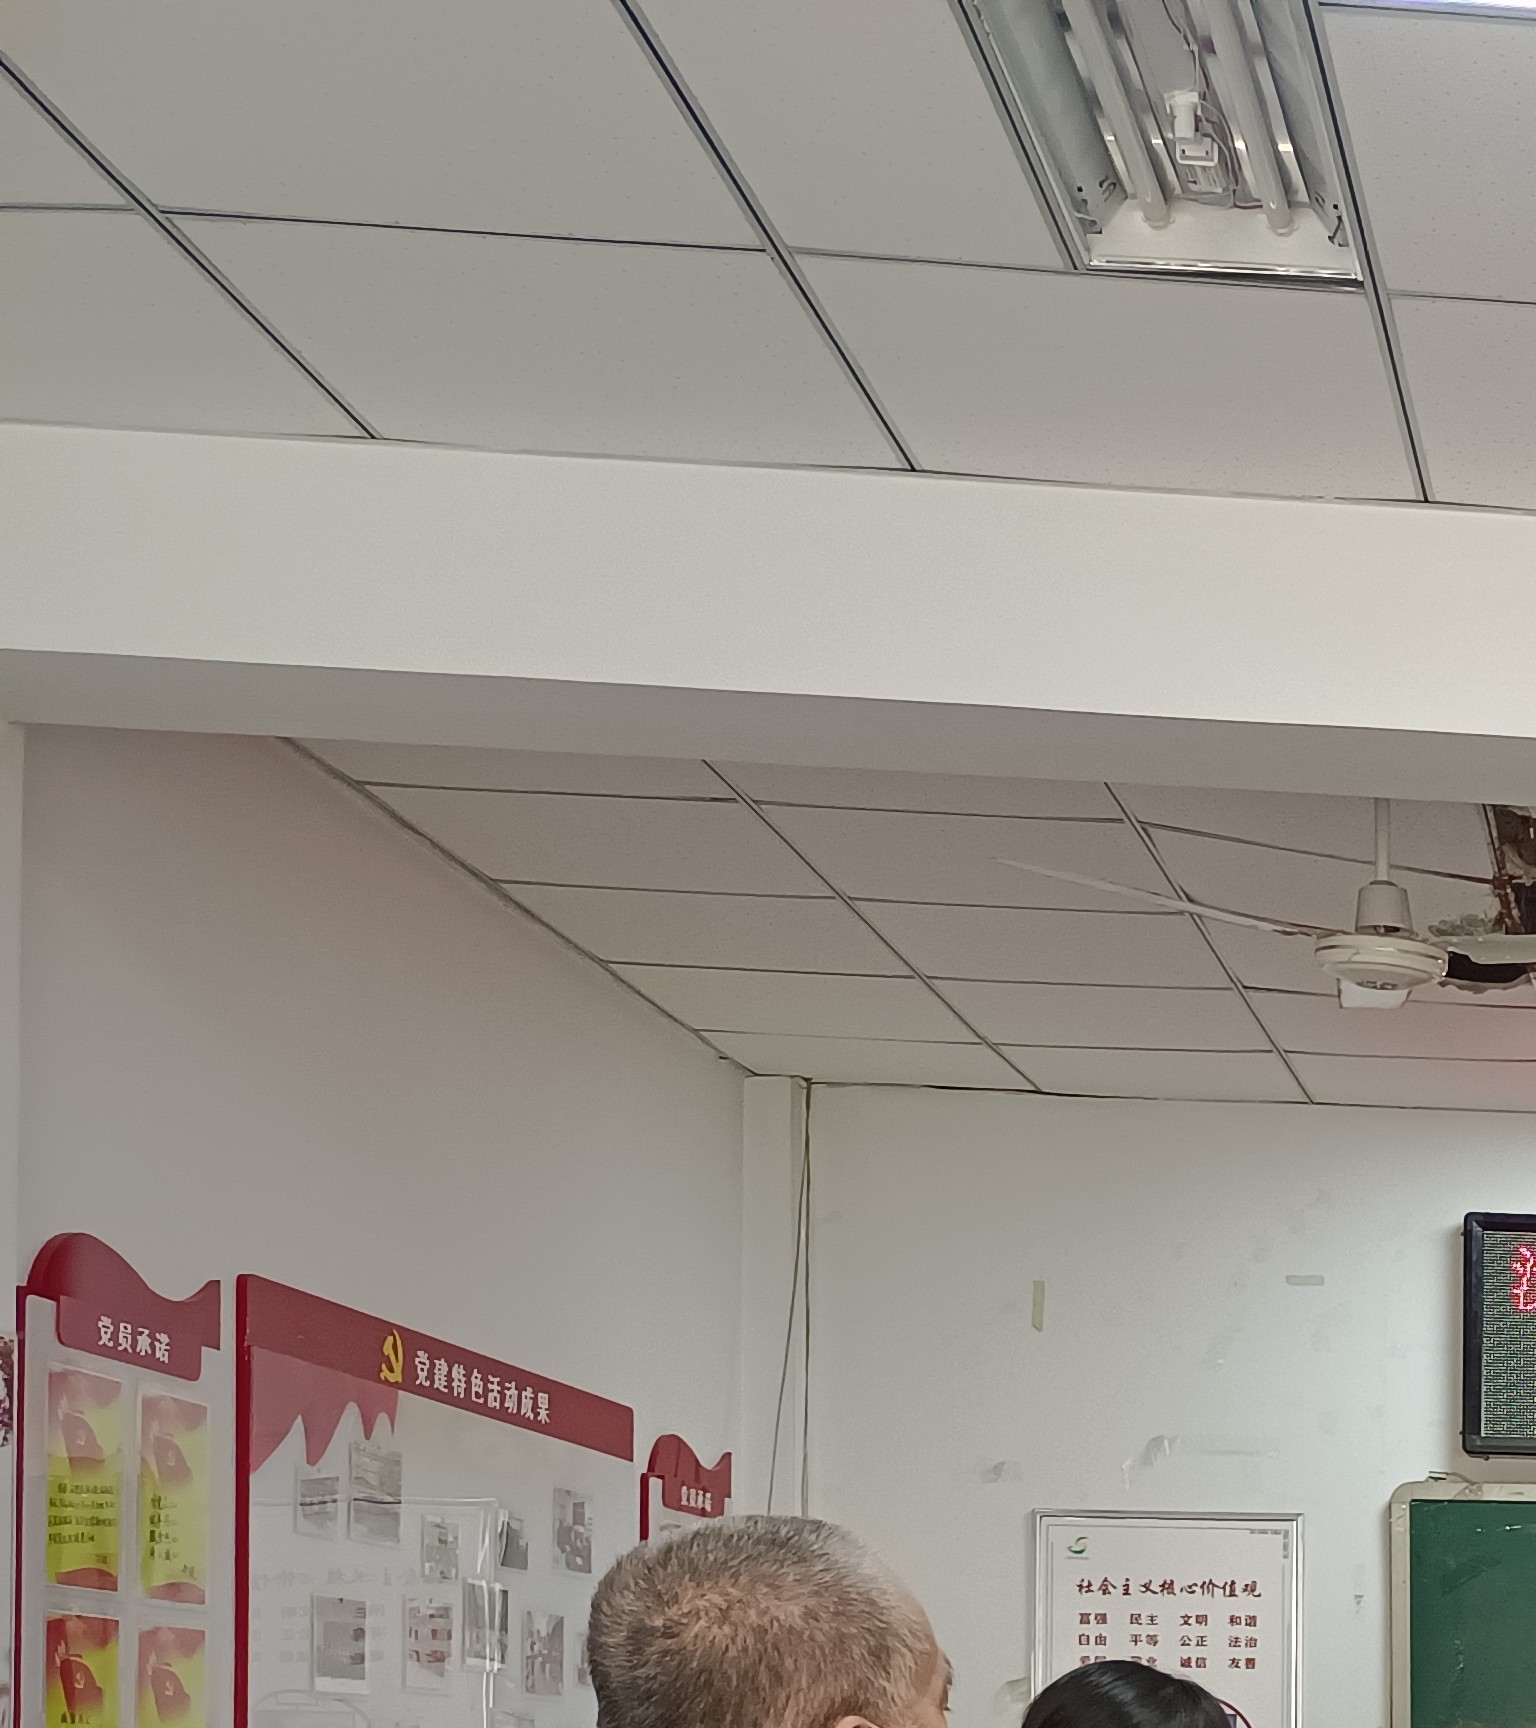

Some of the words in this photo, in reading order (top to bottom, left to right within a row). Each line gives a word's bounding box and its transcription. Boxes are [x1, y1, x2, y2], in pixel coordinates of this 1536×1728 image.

[97, 1315, 171, 1364] 党员承诺
[414, 1350, 551, 1425] 党建特色活动成果
[1076, 1576, 1262, 1599] 社会主义核心价值观
[1130, 1613, 1159, 1626] 民主
[1179, 1613, 1208, 1627] 文明
[1228, 1614, 1258, 1628] 和谐
[1078, 1633, 1107, 1647] 自由
[1129, 1633, 1160, 1647] 平等
[1179, 1635, 1208, 1647] 公正
[1228, 1635, 1258, 1649] 法治
[1180, 1656, 1208, 1669] 诚信
[1228, 1657, 1257, 1670] 友善
